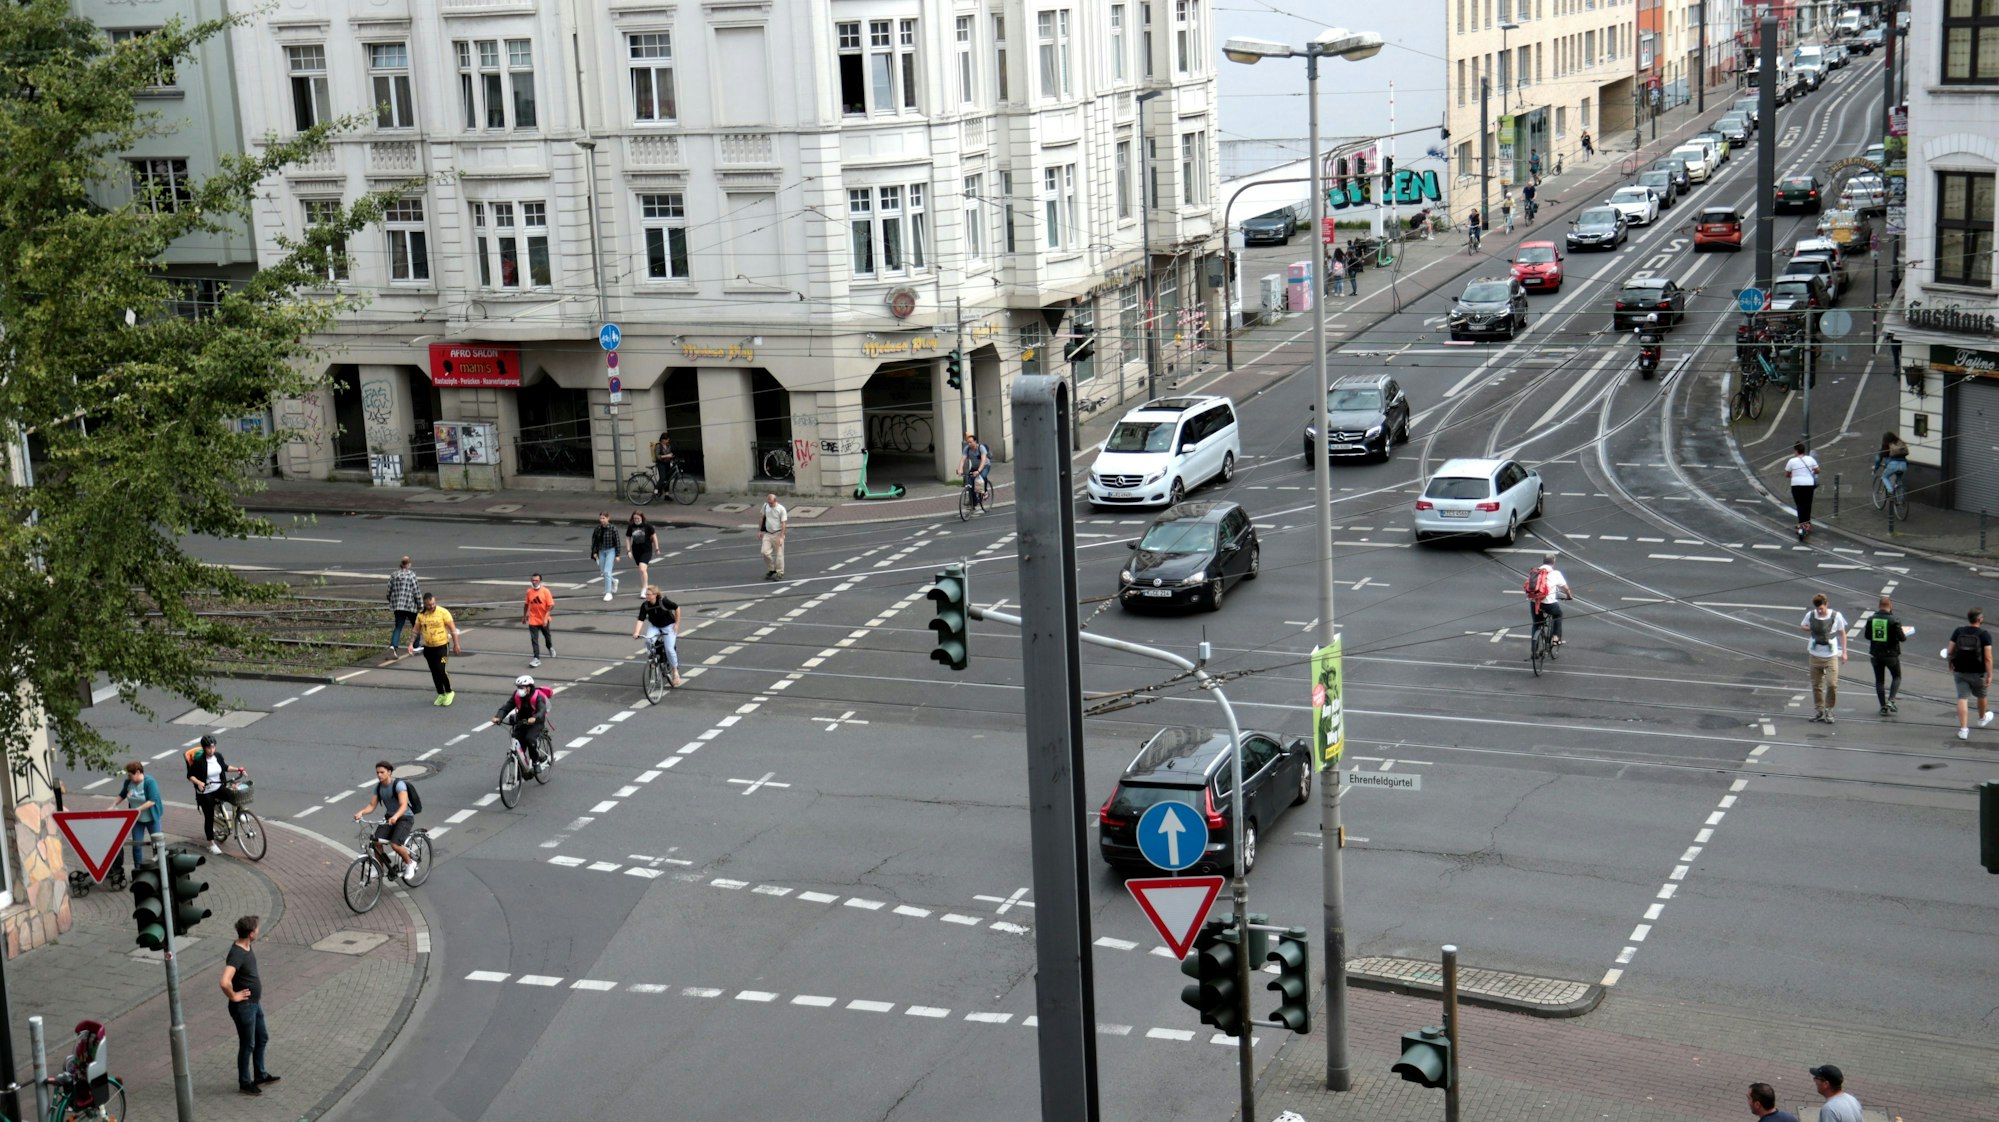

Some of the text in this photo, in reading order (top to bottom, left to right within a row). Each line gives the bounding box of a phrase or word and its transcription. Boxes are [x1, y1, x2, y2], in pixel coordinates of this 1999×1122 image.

[1908, 300, 1995, 331] Gasthaus
[450, 349, 499, 358] AFRO SALON
[1349, 773, 1413, 788] Ehrenfeldgürtel
